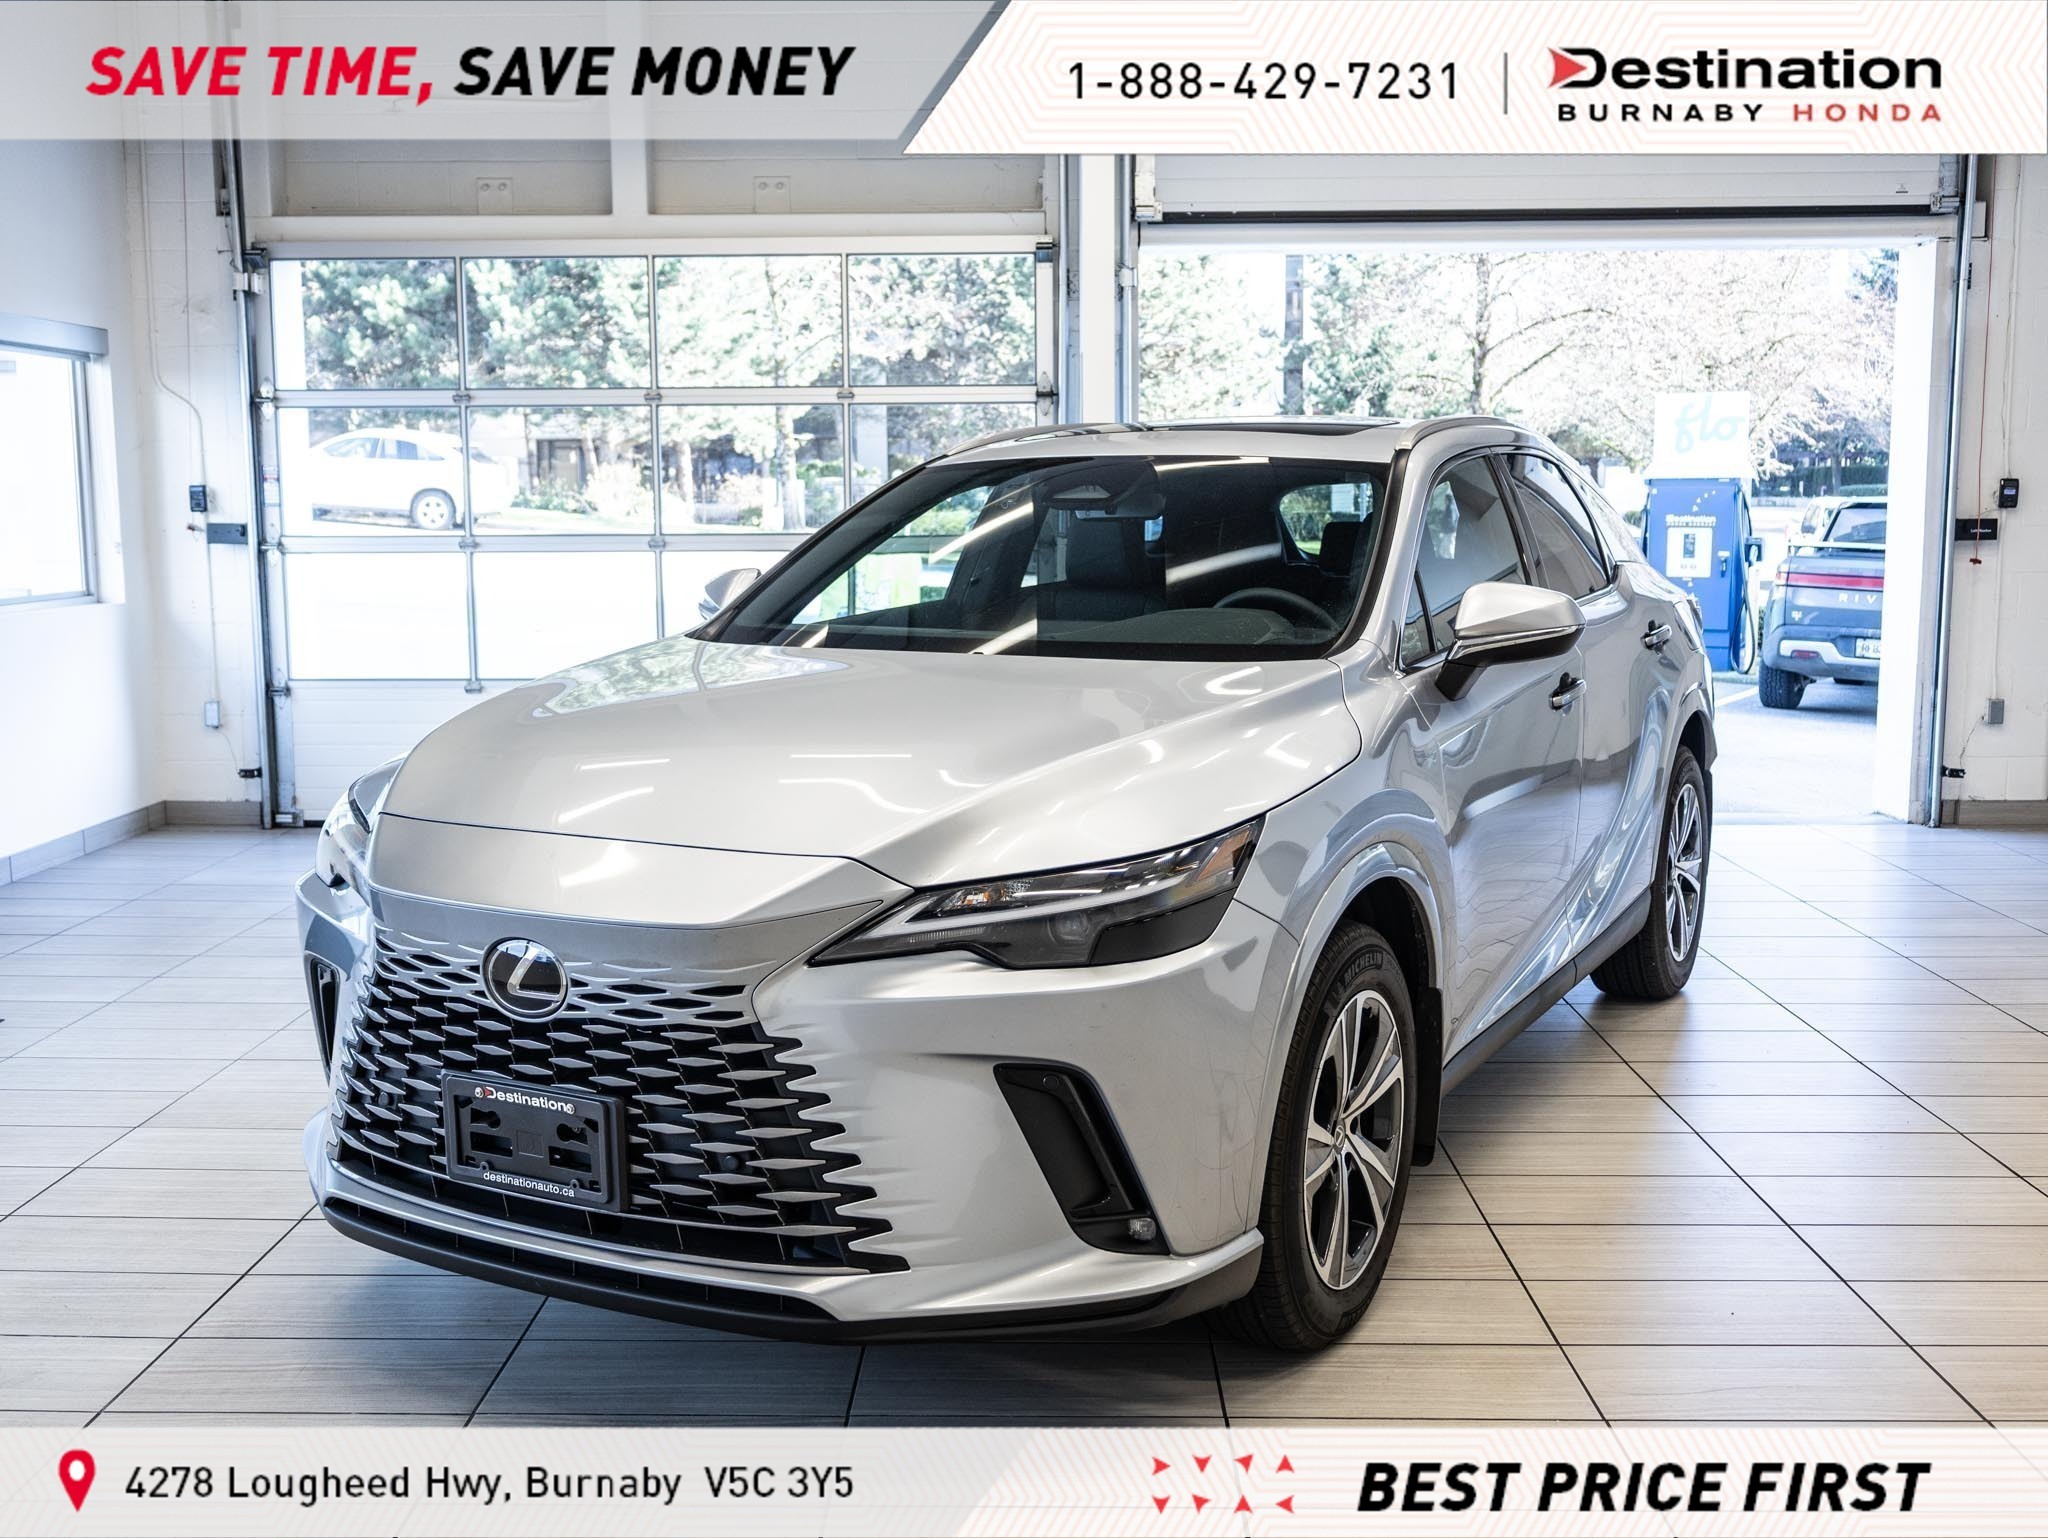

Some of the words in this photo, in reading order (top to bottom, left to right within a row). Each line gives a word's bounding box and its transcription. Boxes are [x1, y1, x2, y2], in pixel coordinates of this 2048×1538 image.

[1674, 392, 1746, 453] flo
[1838, 592, 1878, 604] RIV
[482, 1086, 568, 1113] Destination
[483, 1171, 575, 1198] destinationauto.ca
